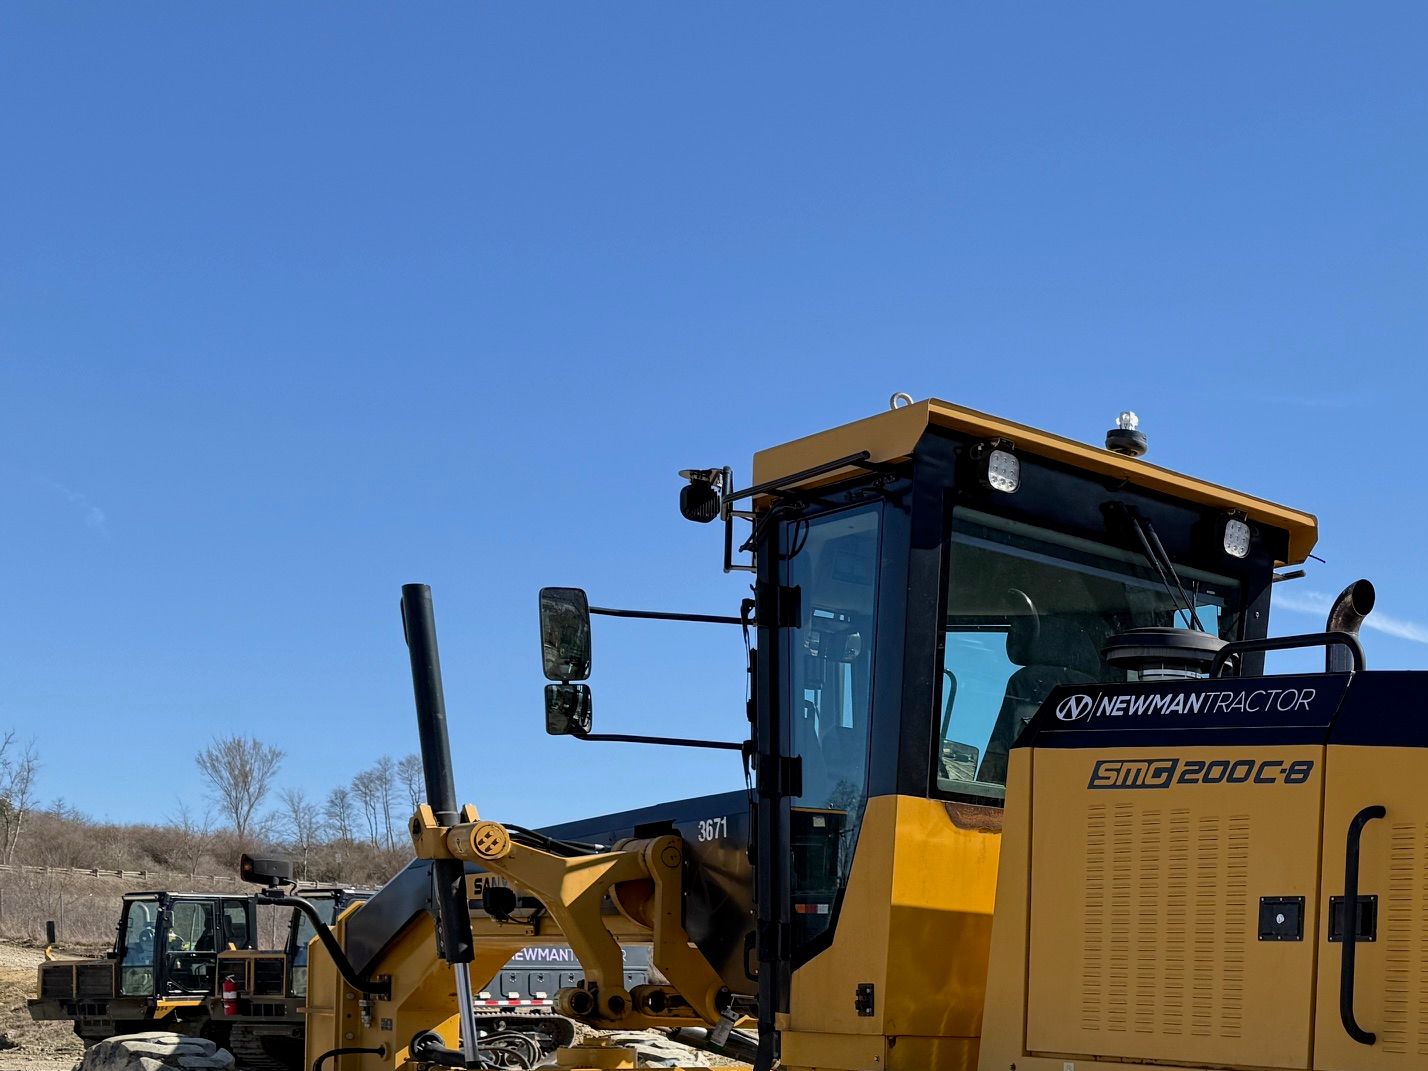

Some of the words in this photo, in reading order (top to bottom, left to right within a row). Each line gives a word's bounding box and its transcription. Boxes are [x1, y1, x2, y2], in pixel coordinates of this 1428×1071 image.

[1089, 759, 1177, 789] SMG
[1176, 760, 1315, 785] 200C-8
[698, 816, 727, 842] 3671
